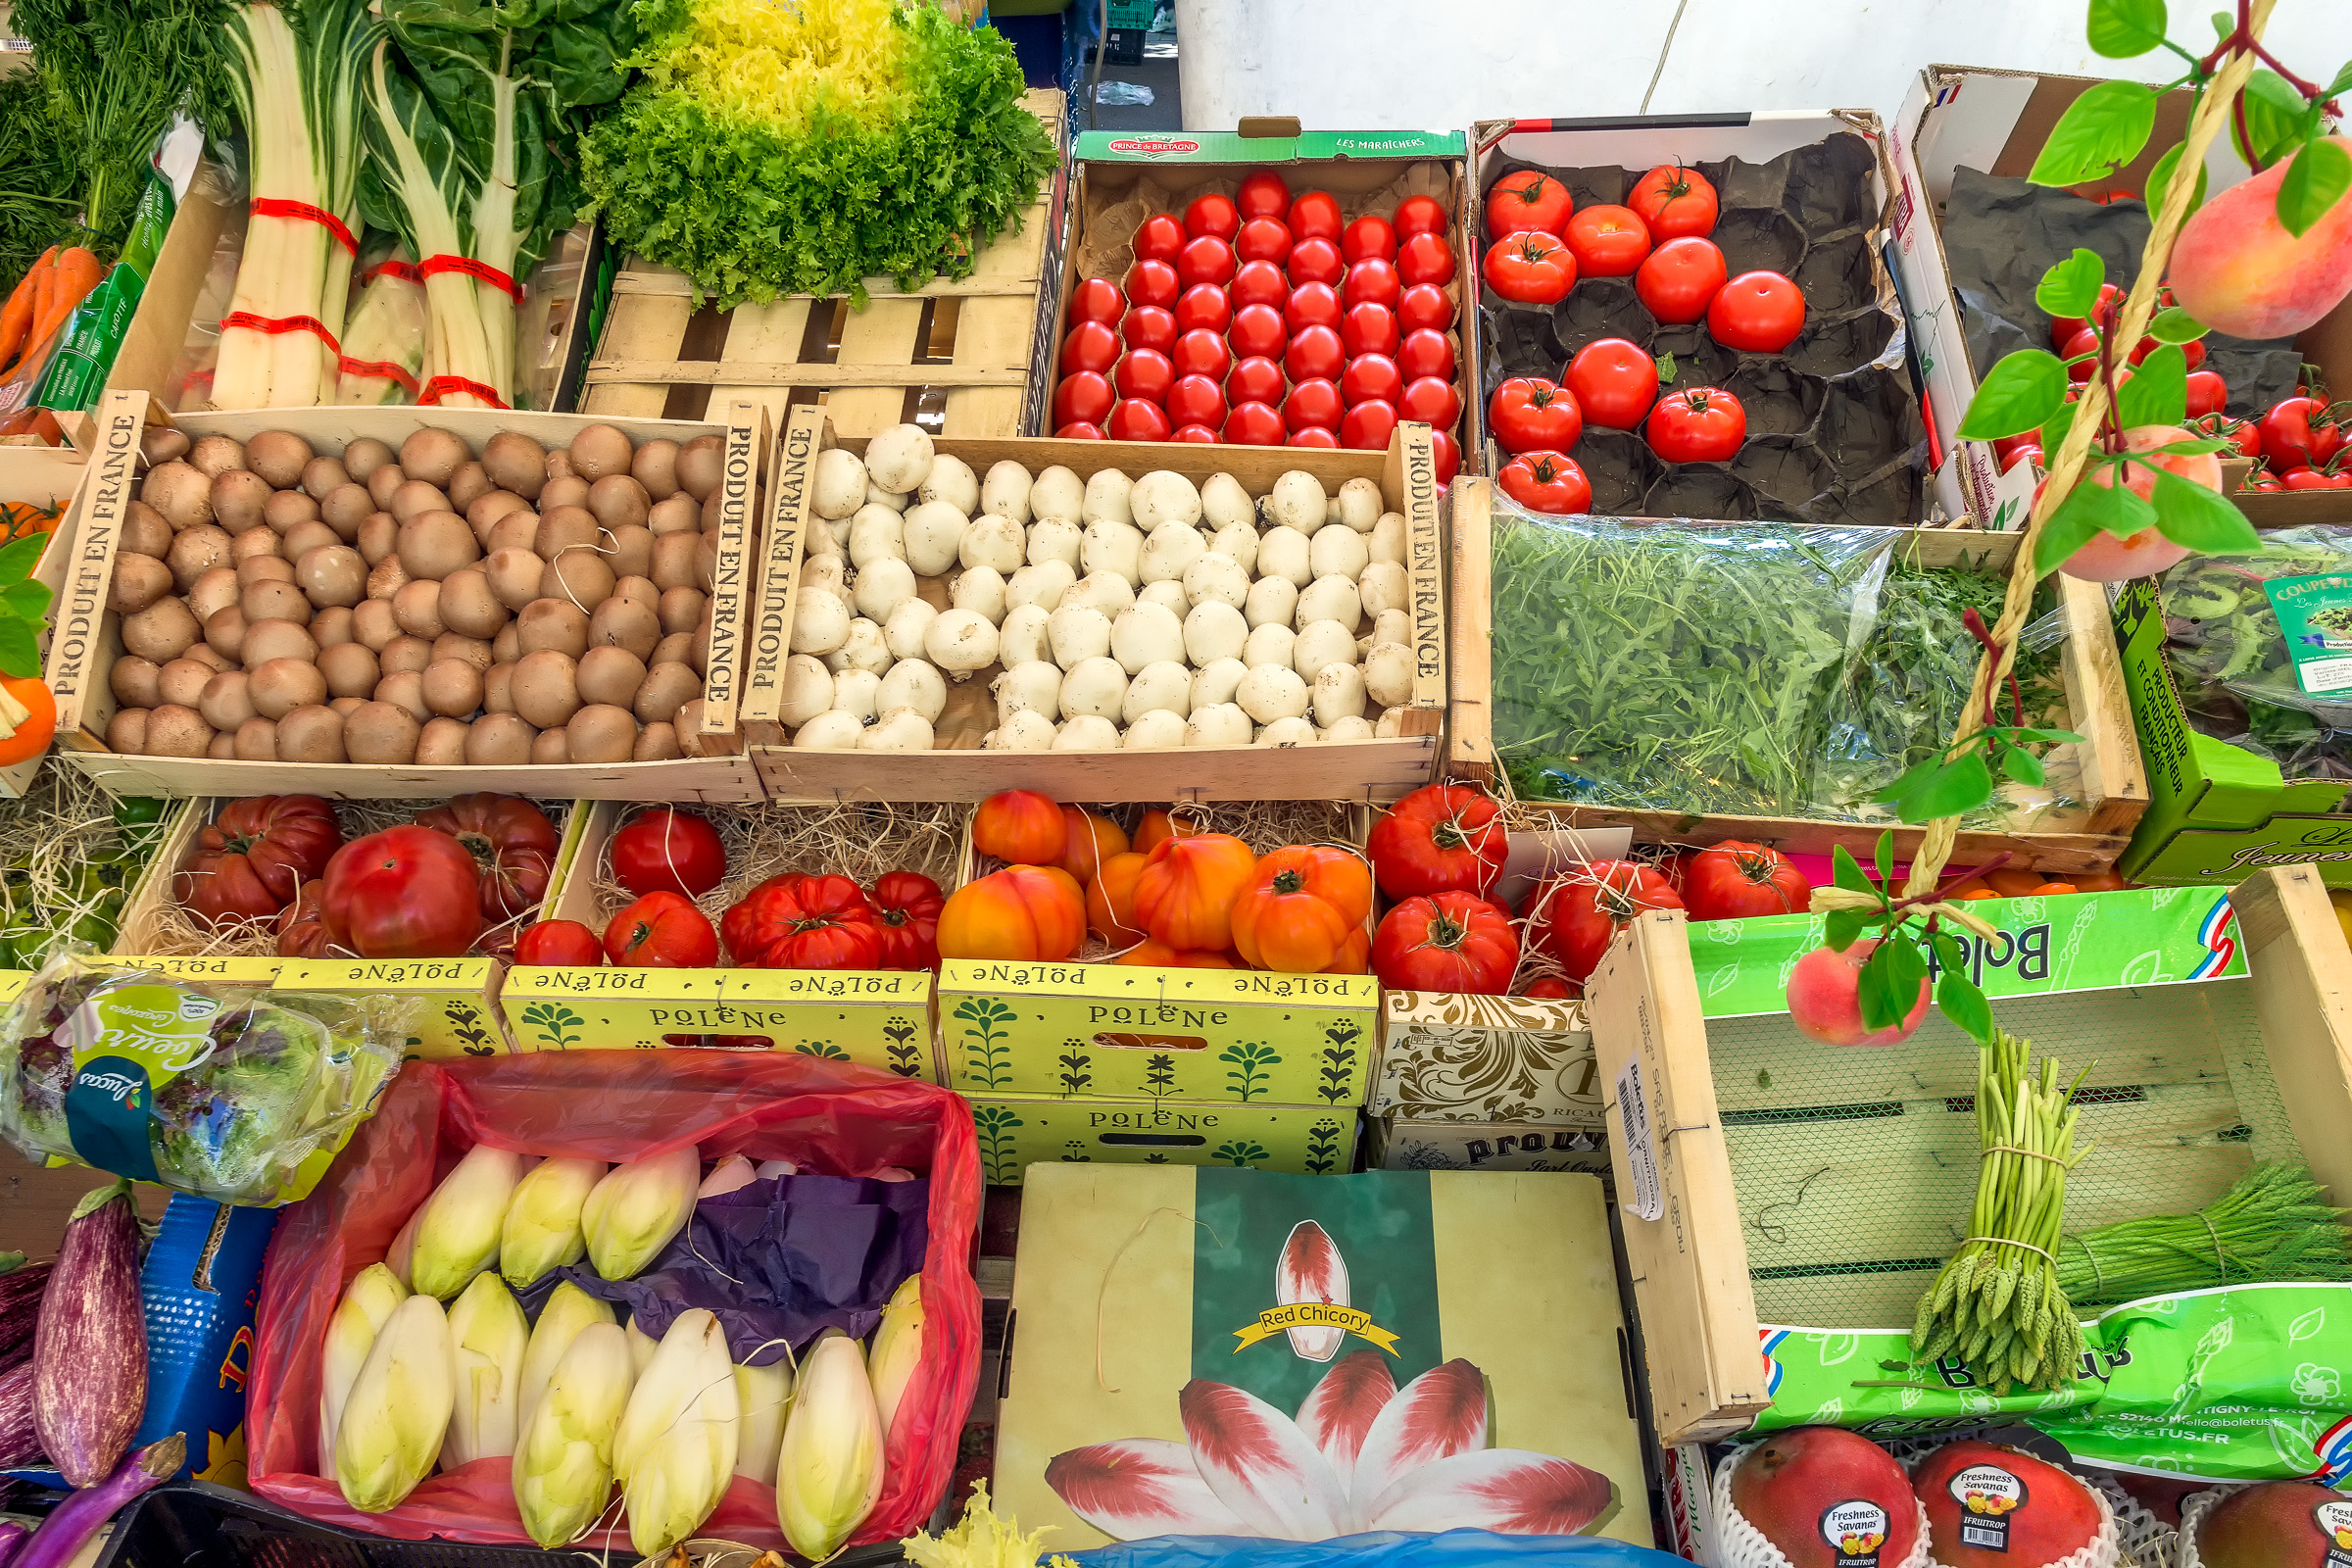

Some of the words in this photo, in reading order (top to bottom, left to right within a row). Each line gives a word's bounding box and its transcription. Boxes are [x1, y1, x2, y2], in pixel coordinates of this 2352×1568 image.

[1336, 137, 1354, 148] LES
[92, 415, 135, 520] FRANCE
[720, 425, 752, 545] PRODUIT
[783, 427, 812, 524] FRANCE
[1409, 443, 1436, 538] PRODUIT
[82, 524, 111, 563] EN
[771, 527, 797, 564] EN
[1413, 541, 1436, 571] EN
[717, 550, 741, 587] EN
[2276, 578, 2329, 601] COUPE
[55, 566, 102, 697] PRODUIT
[753, 566, 790, 689] PRODUIT
[1415, 576, 1441, 678] FRANCE
[708, 592, 741, 703] FRANCE
[2136, 658, 2147, 678] ET
[2143, 677, 2184, 799] CONDITIONNEUR
[2152, 667, 2188, 762] PRODUCTEUR
[2139, 703, 2166, 776] FRANÇAIS
[79, 1072, 143, 1102] Lucas
[1631, 1063, 1646, 1130] Boletus
[1552, 1107, 1606, 1118] RICAU
[1261, 1307, 1296, 1328] Red
[1299, 1306, 1369, 1331] Chicory
[1960, 1472, 2012, 1484] Freshness
[1963, 1481, 2009, 1493] Savanas
[1832, 1509, 1880, 1522] Freshness
[1837, 1520, 1878, 1532] Savanas
[1963, 1516, 2006, 1530] IFRUITROP
[1838, 1558, 1877, 1567] IFRUITROP
